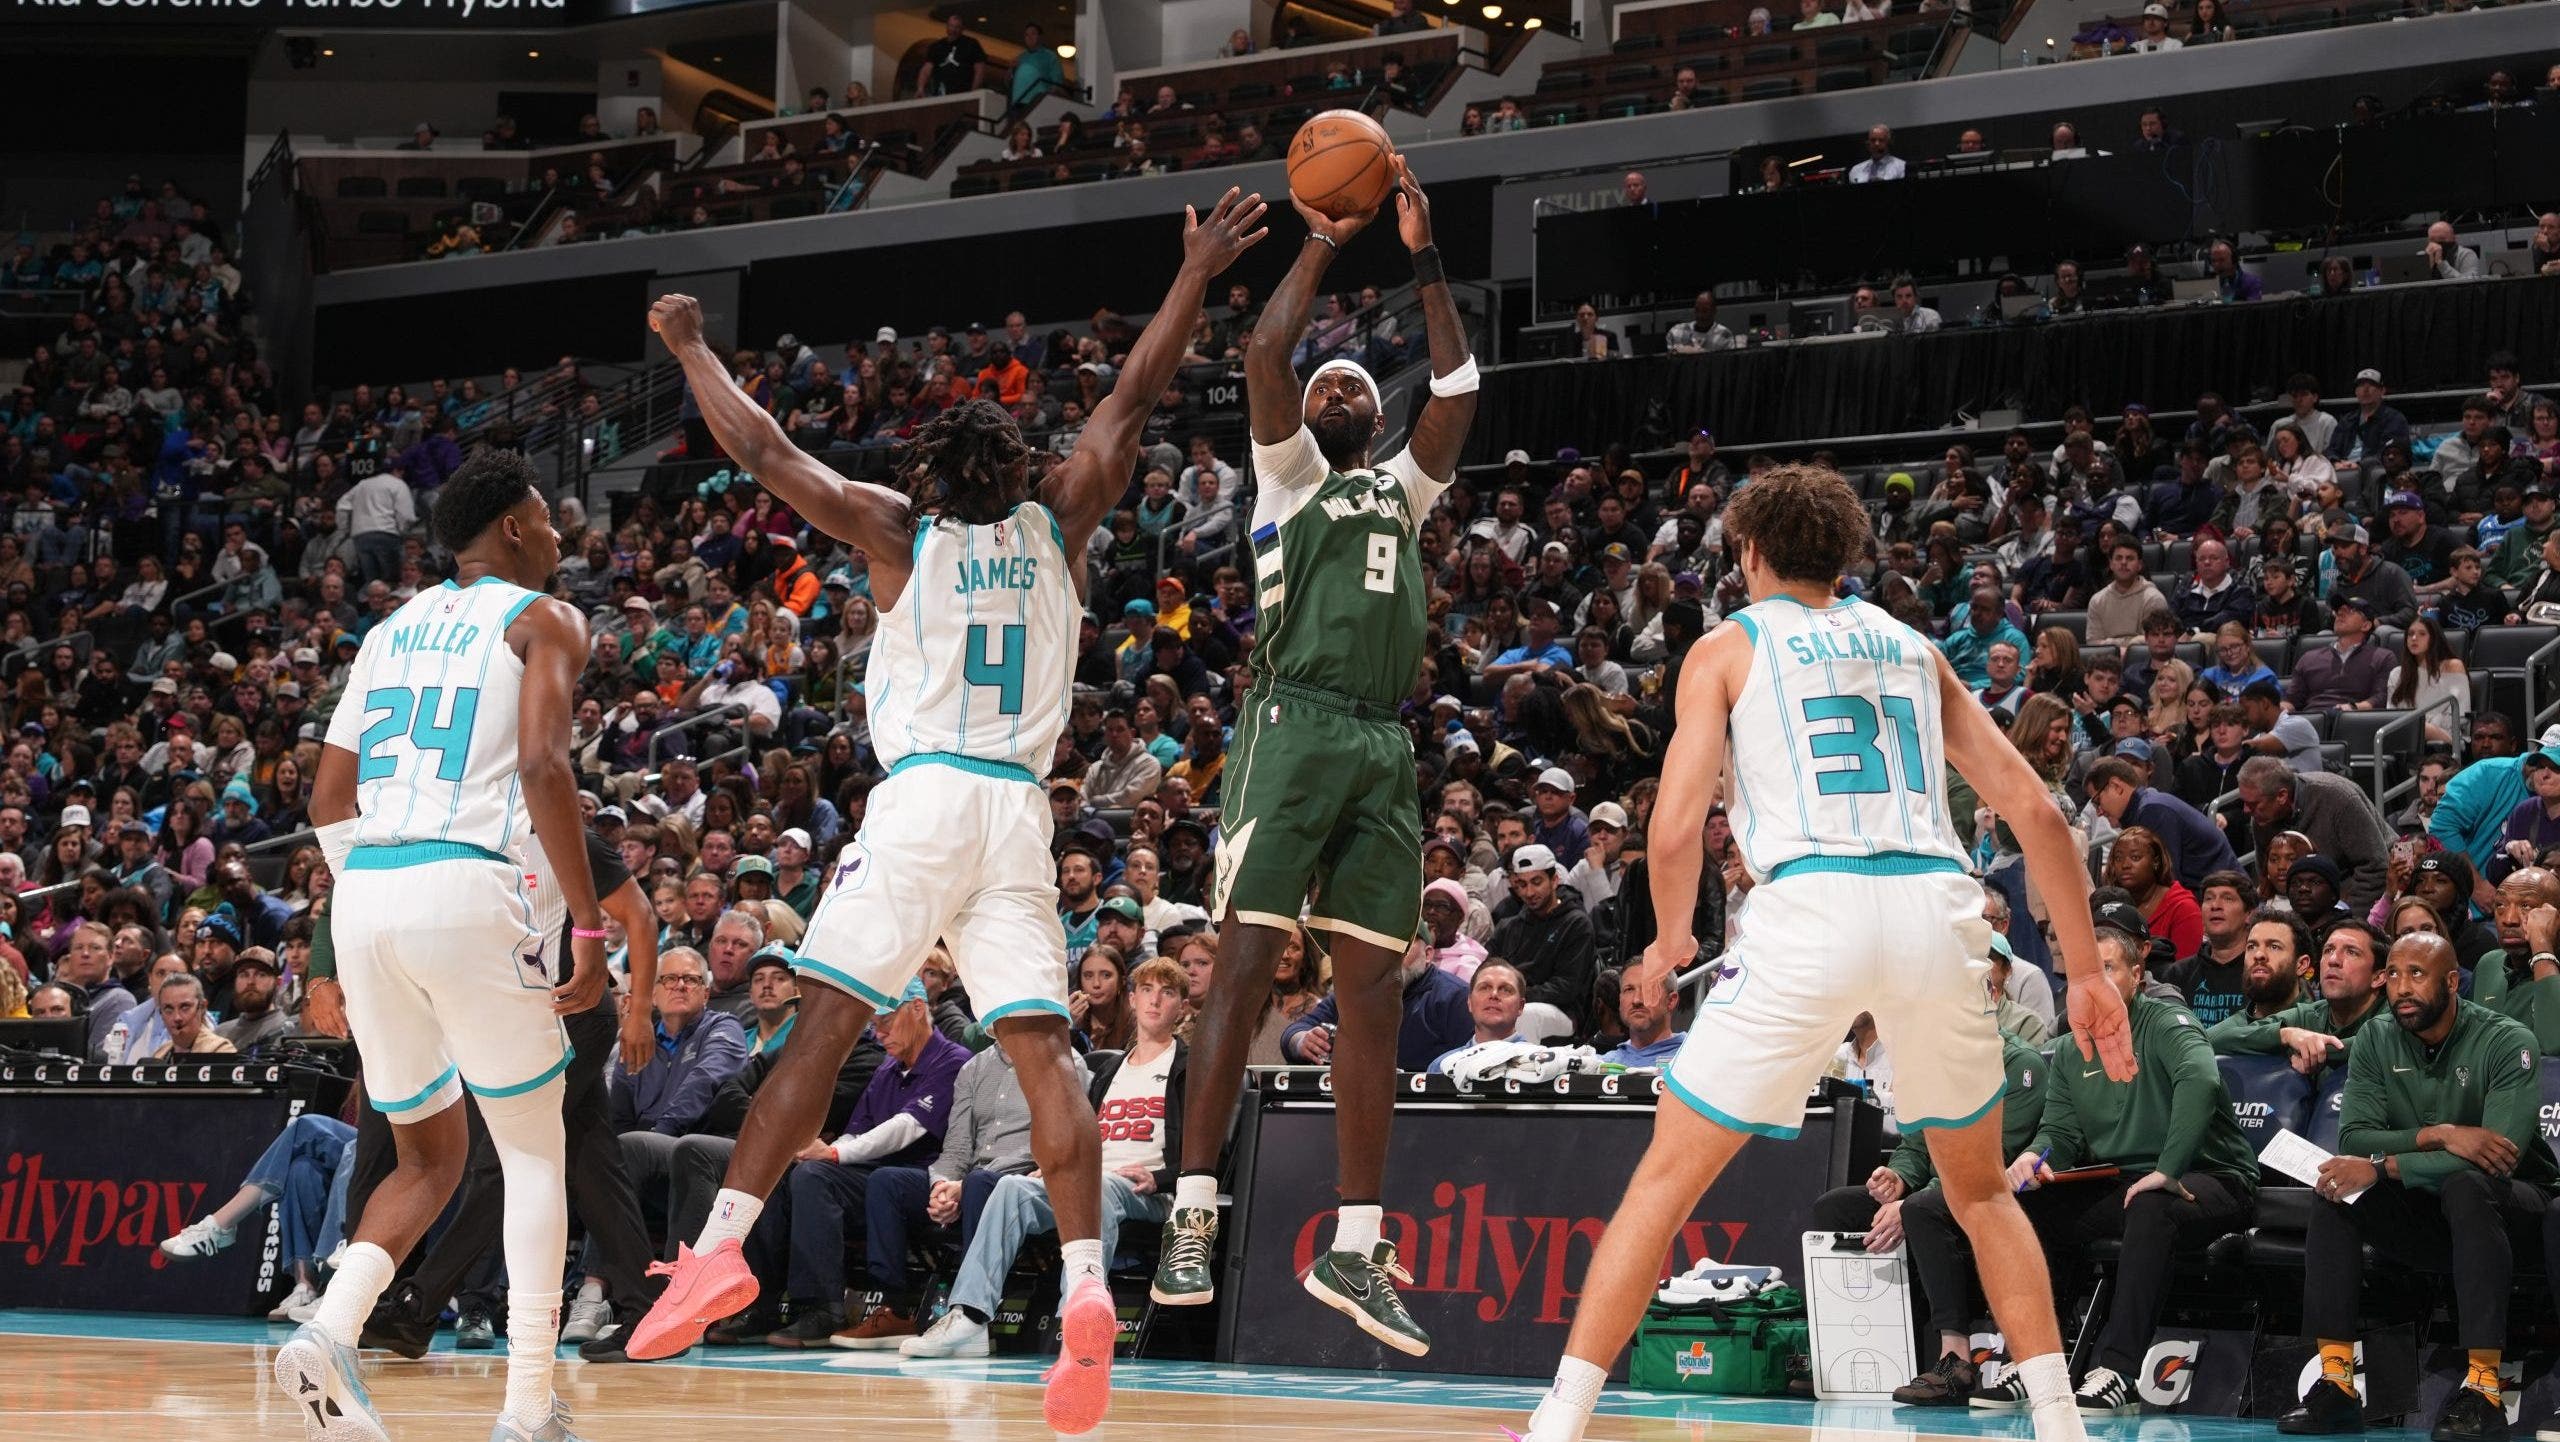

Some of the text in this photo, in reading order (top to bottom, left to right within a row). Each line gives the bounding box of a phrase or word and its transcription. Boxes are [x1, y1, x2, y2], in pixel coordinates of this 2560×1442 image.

[1206, 386, 1239, 404] 104
[351, 459, 375, 475] 103
[955, 557, 1038, 594] JAMES
[1365, 532, 1398, 594] 9
[390, 622, 480, 658] MILLER
[1787, 629, 1903, 667] SALAÜN
[963, 624, 1026, 715] 4
[358, 686, 479, 785] 24
[1802, 695, 1926, 795] 31
[2193, 994, 2244, 1007] CHAROTTE
[1097, 1096, 1167, 1121] OSS
